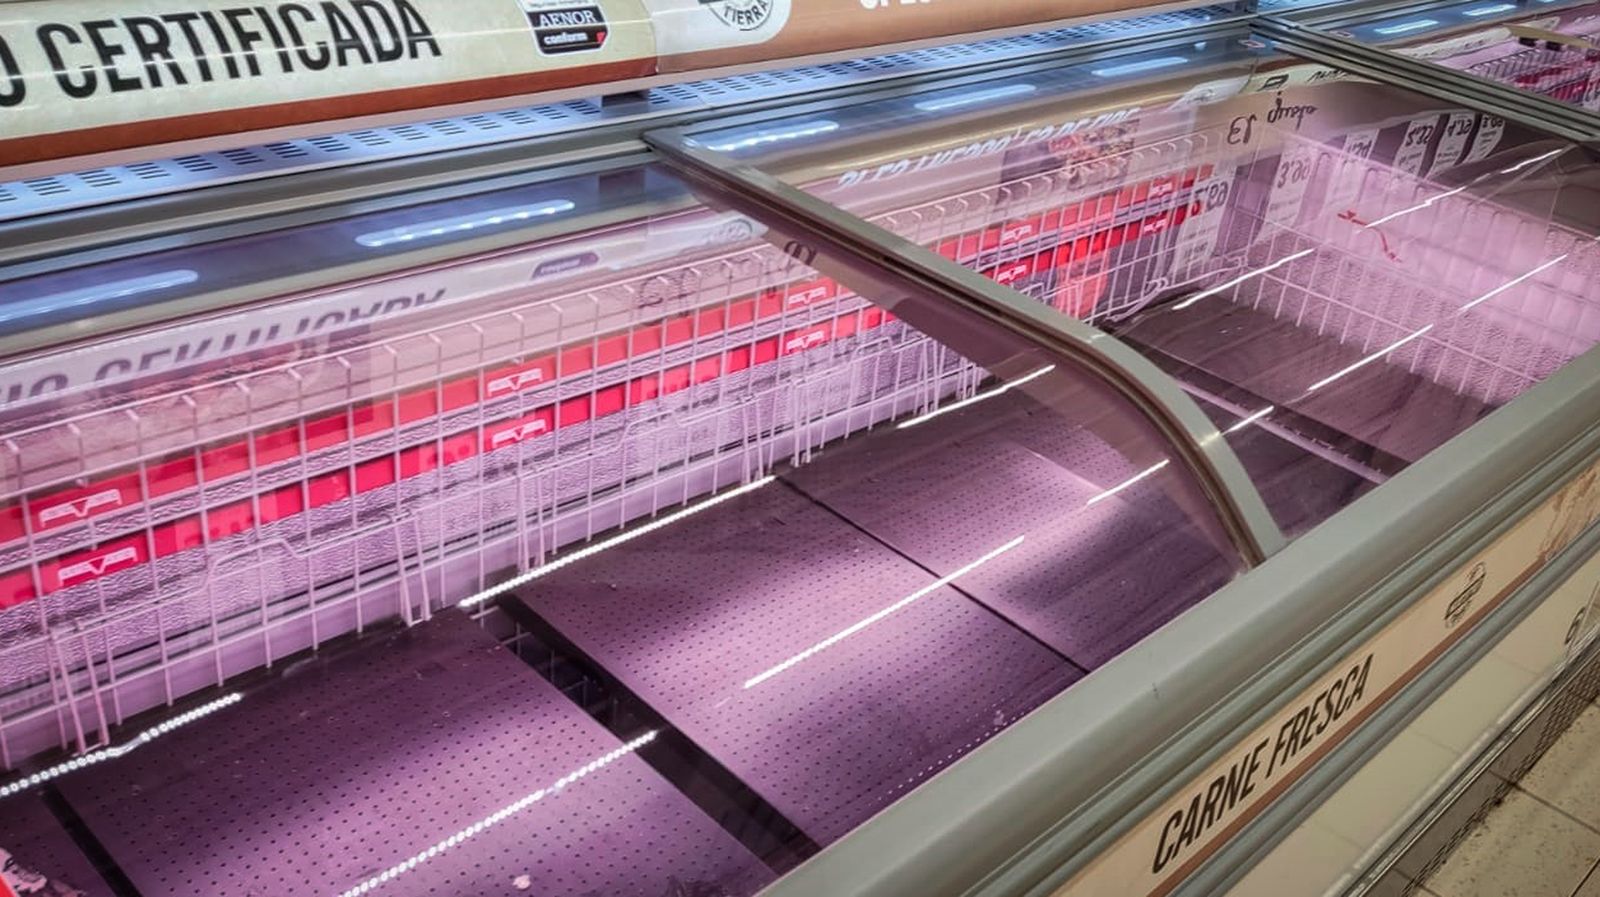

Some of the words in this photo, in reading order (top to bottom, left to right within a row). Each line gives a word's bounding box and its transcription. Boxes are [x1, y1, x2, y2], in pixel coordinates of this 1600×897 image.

[540, 9, 596, 29] AENOR
[723, 0, 769, 25] TIERRA
[36, 0, 442, 98] CERTIFICADA
[1152, 737, 1270, 875] CARNE
[1266, 653, 1374, 779] FRESCA
